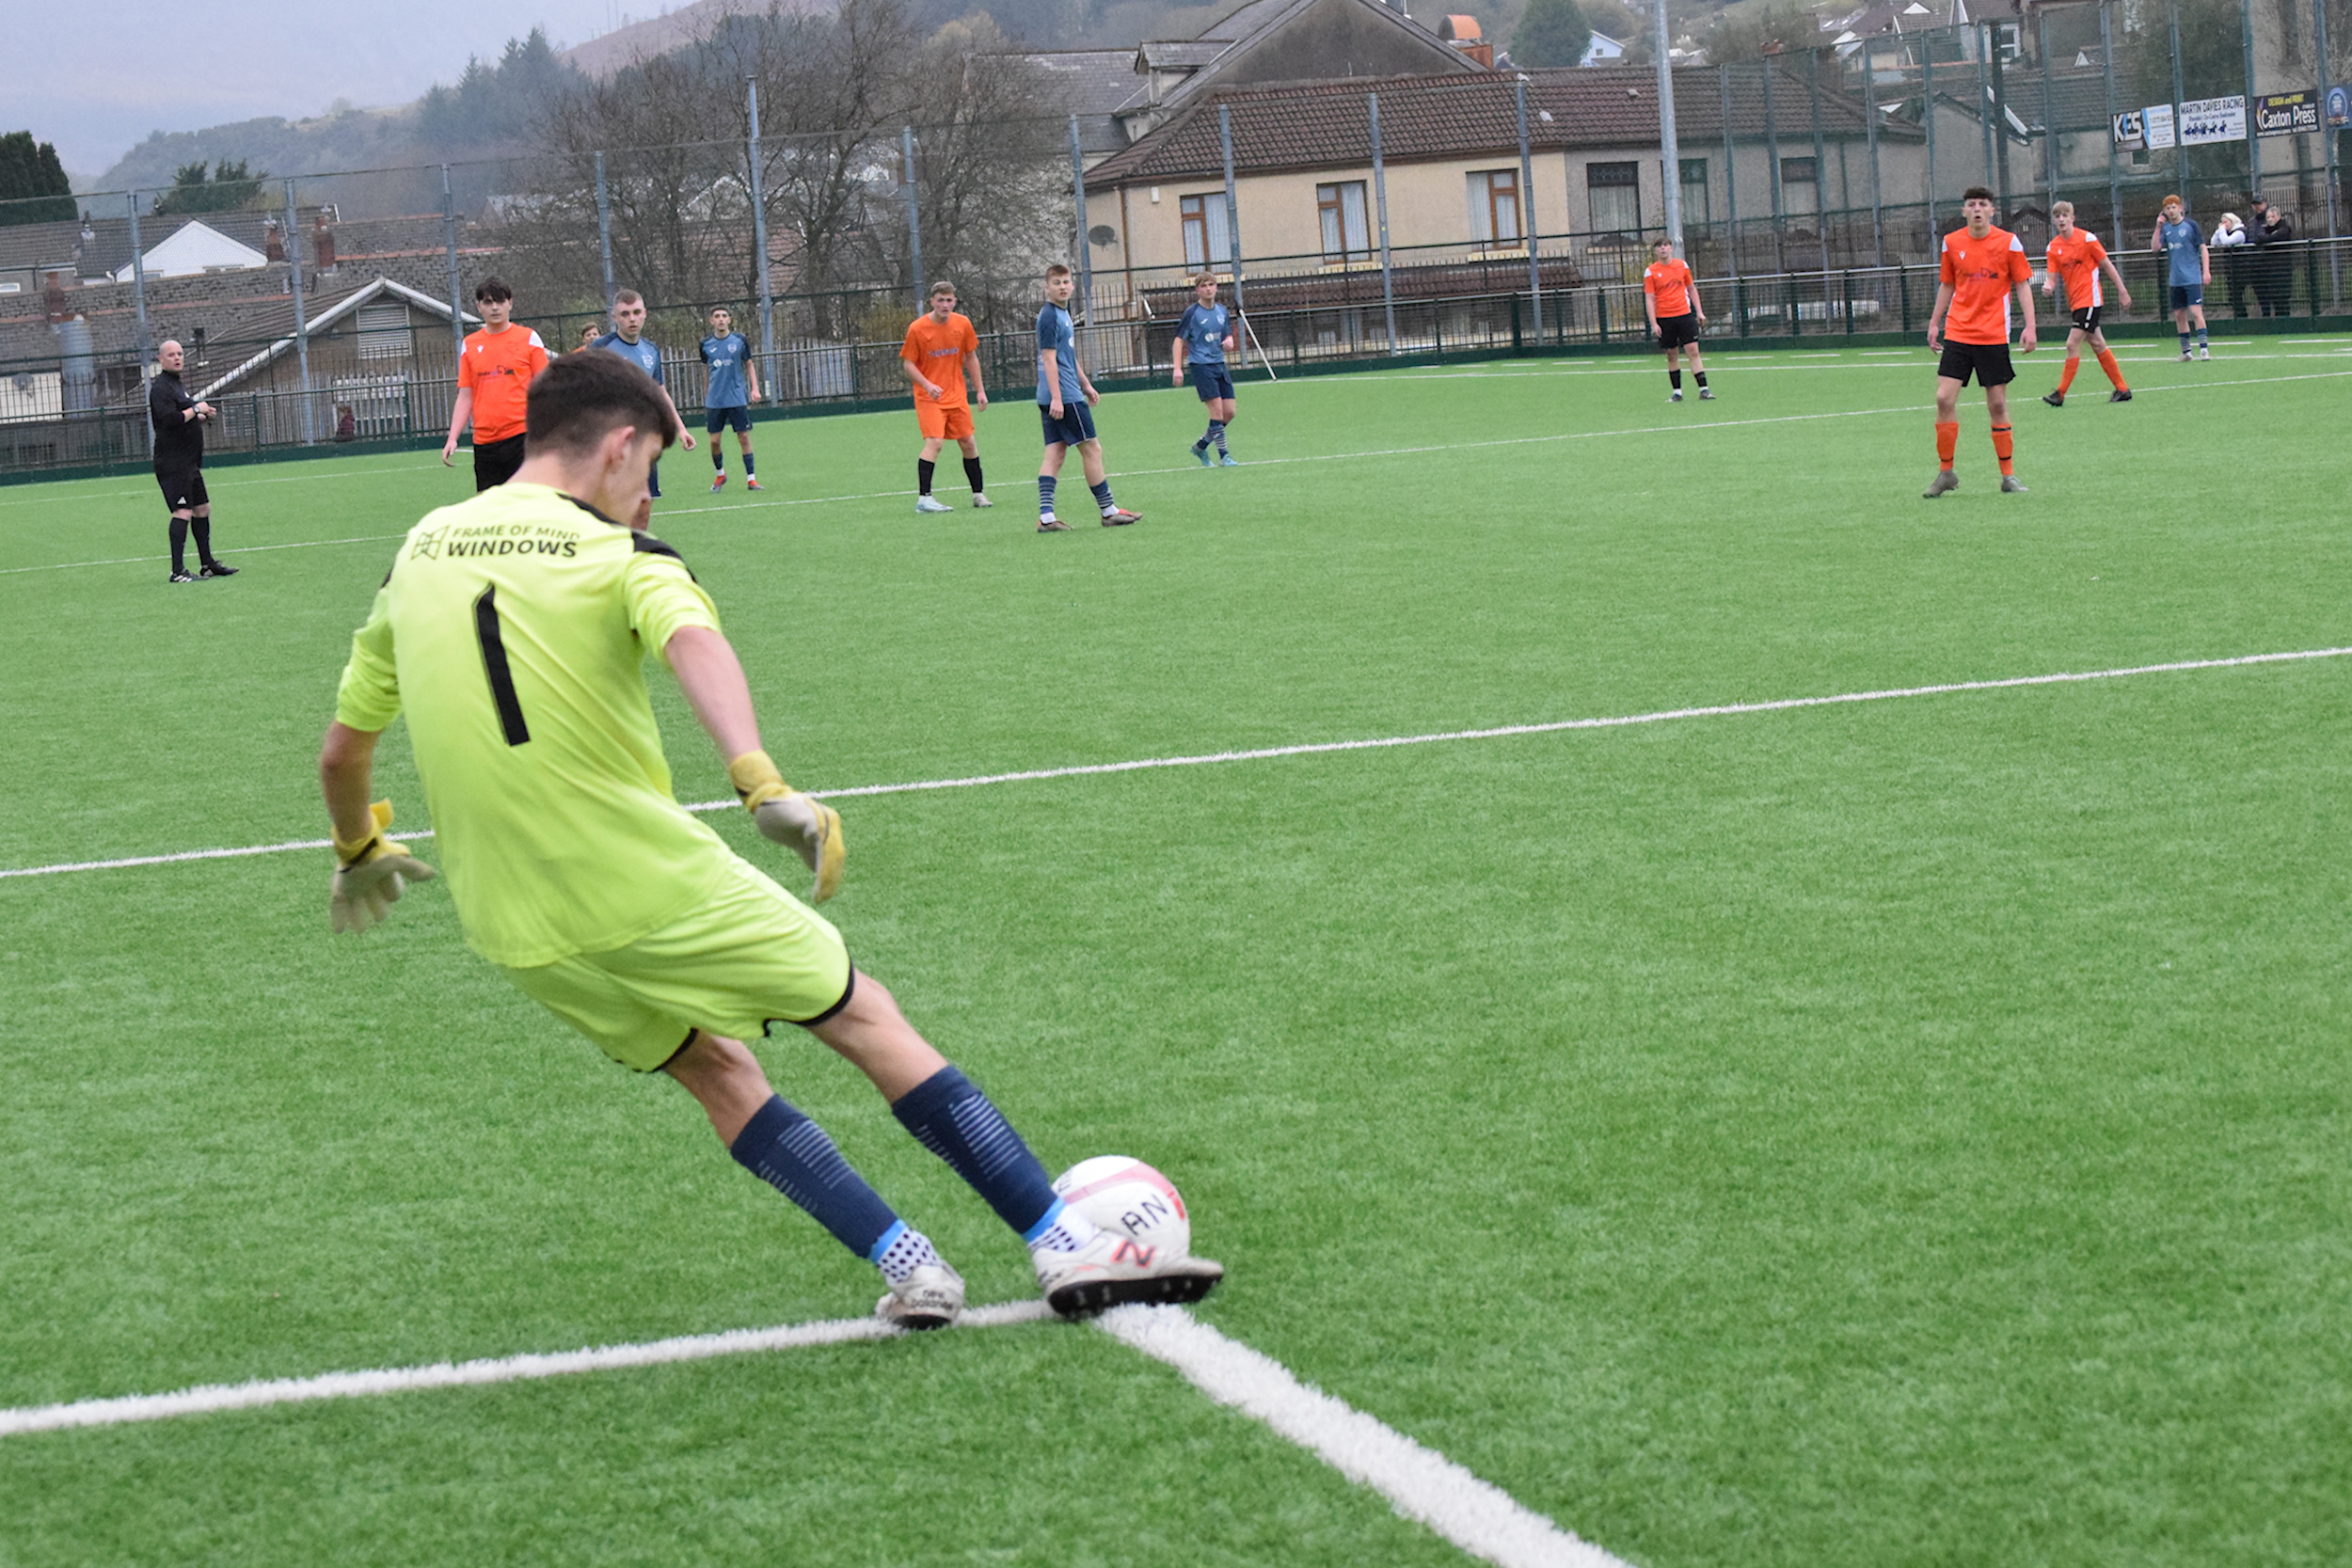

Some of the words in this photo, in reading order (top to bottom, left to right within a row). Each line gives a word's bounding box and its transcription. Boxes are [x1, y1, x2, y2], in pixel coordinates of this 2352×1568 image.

[2181, 103, 2201, 115] MARTIN
[2202, 100, 2221, 113] DAVIES
[2222, 97, 2244, 110] RACING
[2261, 108, 2292, 129] Caxton
[2293, 104, 2316, 125] Press
[2113, 110, 2143, 143] KES
[453, 525, 503, 537] FRAME
[510, 525, 532, 536] OF
[536, 527, 580, 541] MIND
[448, 539, 577, 558] WINDOWS
[472, 579, 531, 747] 1
